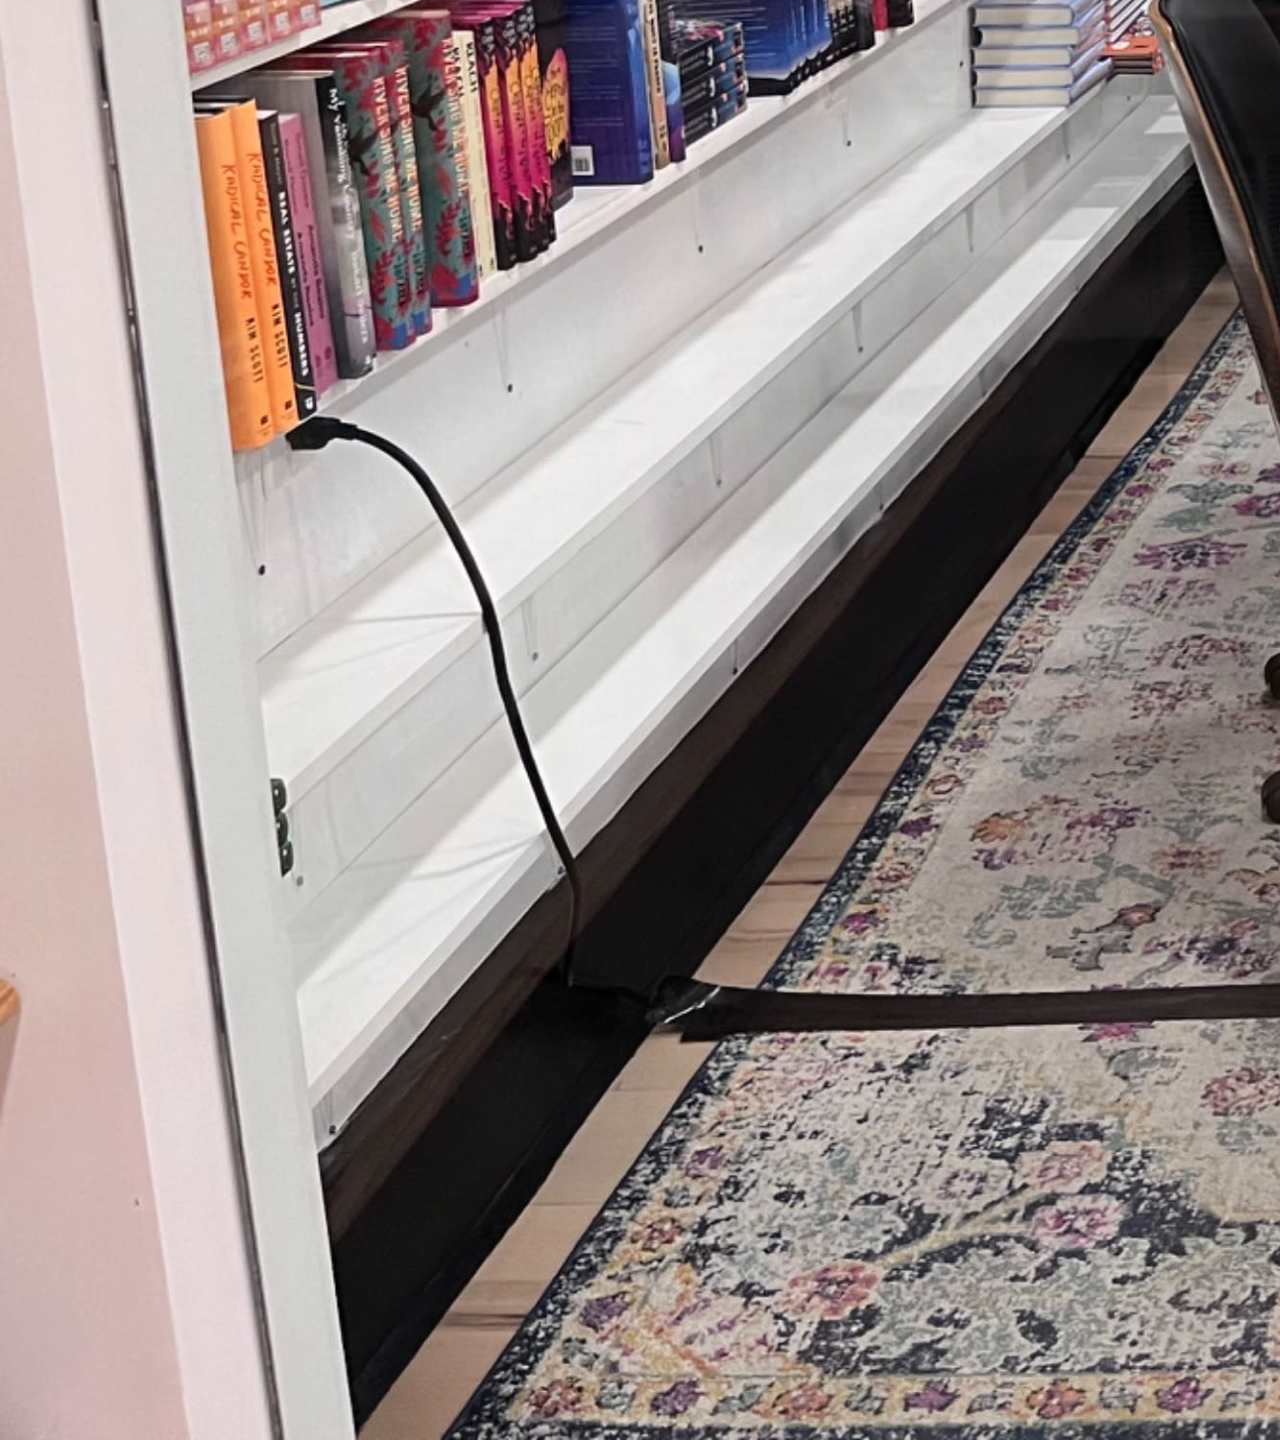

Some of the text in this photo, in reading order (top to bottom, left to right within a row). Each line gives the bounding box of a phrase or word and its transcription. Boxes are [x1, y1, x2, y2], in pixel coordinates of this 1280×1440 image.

[372, 77, 388, 125] RIVER
[394, 66, 411, 116] RIVER
[221, 162, 242, 234] RADICAL
[277, 191, 290, 225] REAL
[232, 240, 254, 301] CANDOR
[247, 150, 288, 368] RADICAL CANDOR KIM SCOTT
[281, 228, 297, 275] ESTATE
[245, 317, 257, 342] KIM
[293, 312, 310, 377] NUMBERS
[248, 346, 264, 385] SCOTT
